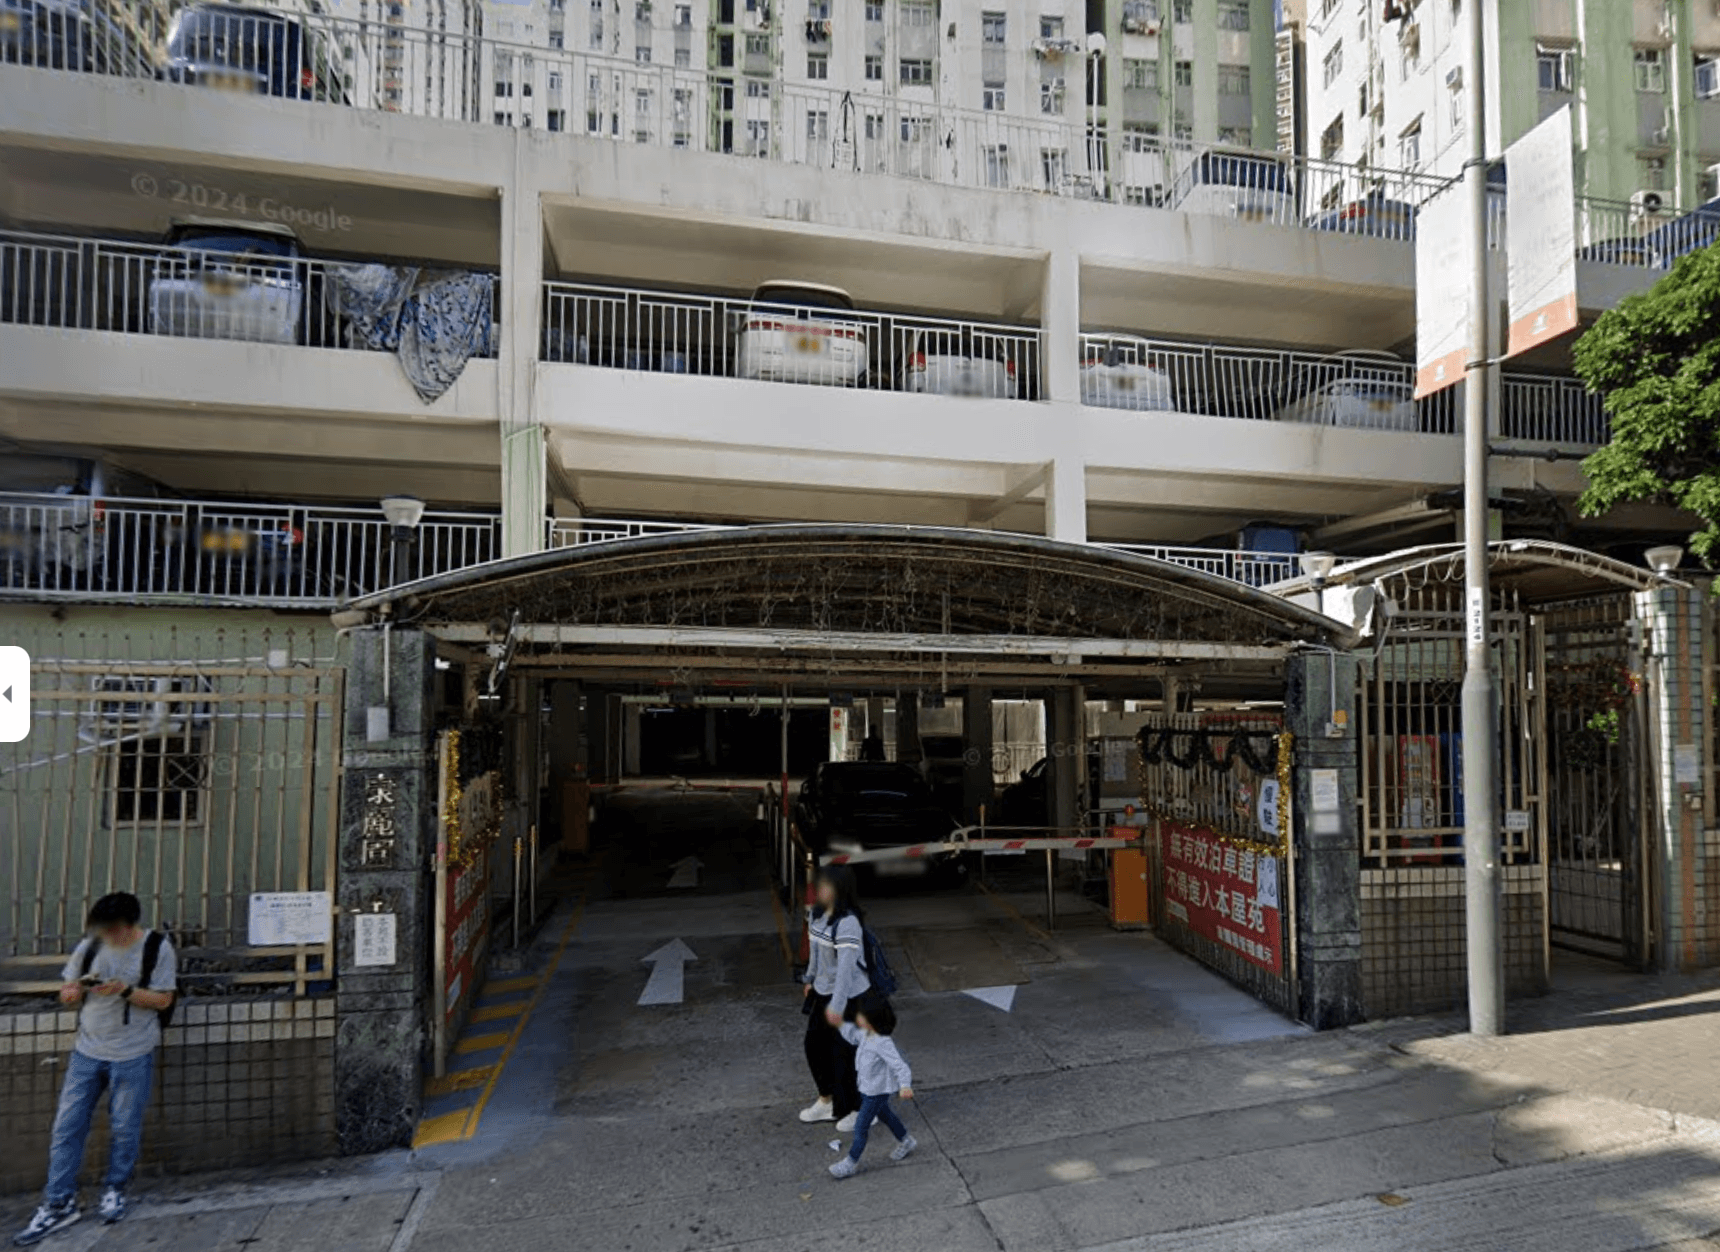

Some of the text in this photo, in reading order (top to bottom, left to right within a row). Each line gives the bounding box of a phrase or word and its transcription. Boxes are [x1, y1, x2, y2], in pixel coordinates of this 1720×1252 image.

[1169, 829, 1255, 885] 無有效泊車證
[1165, 866, 1266, 934] 不得進入本屋苑
